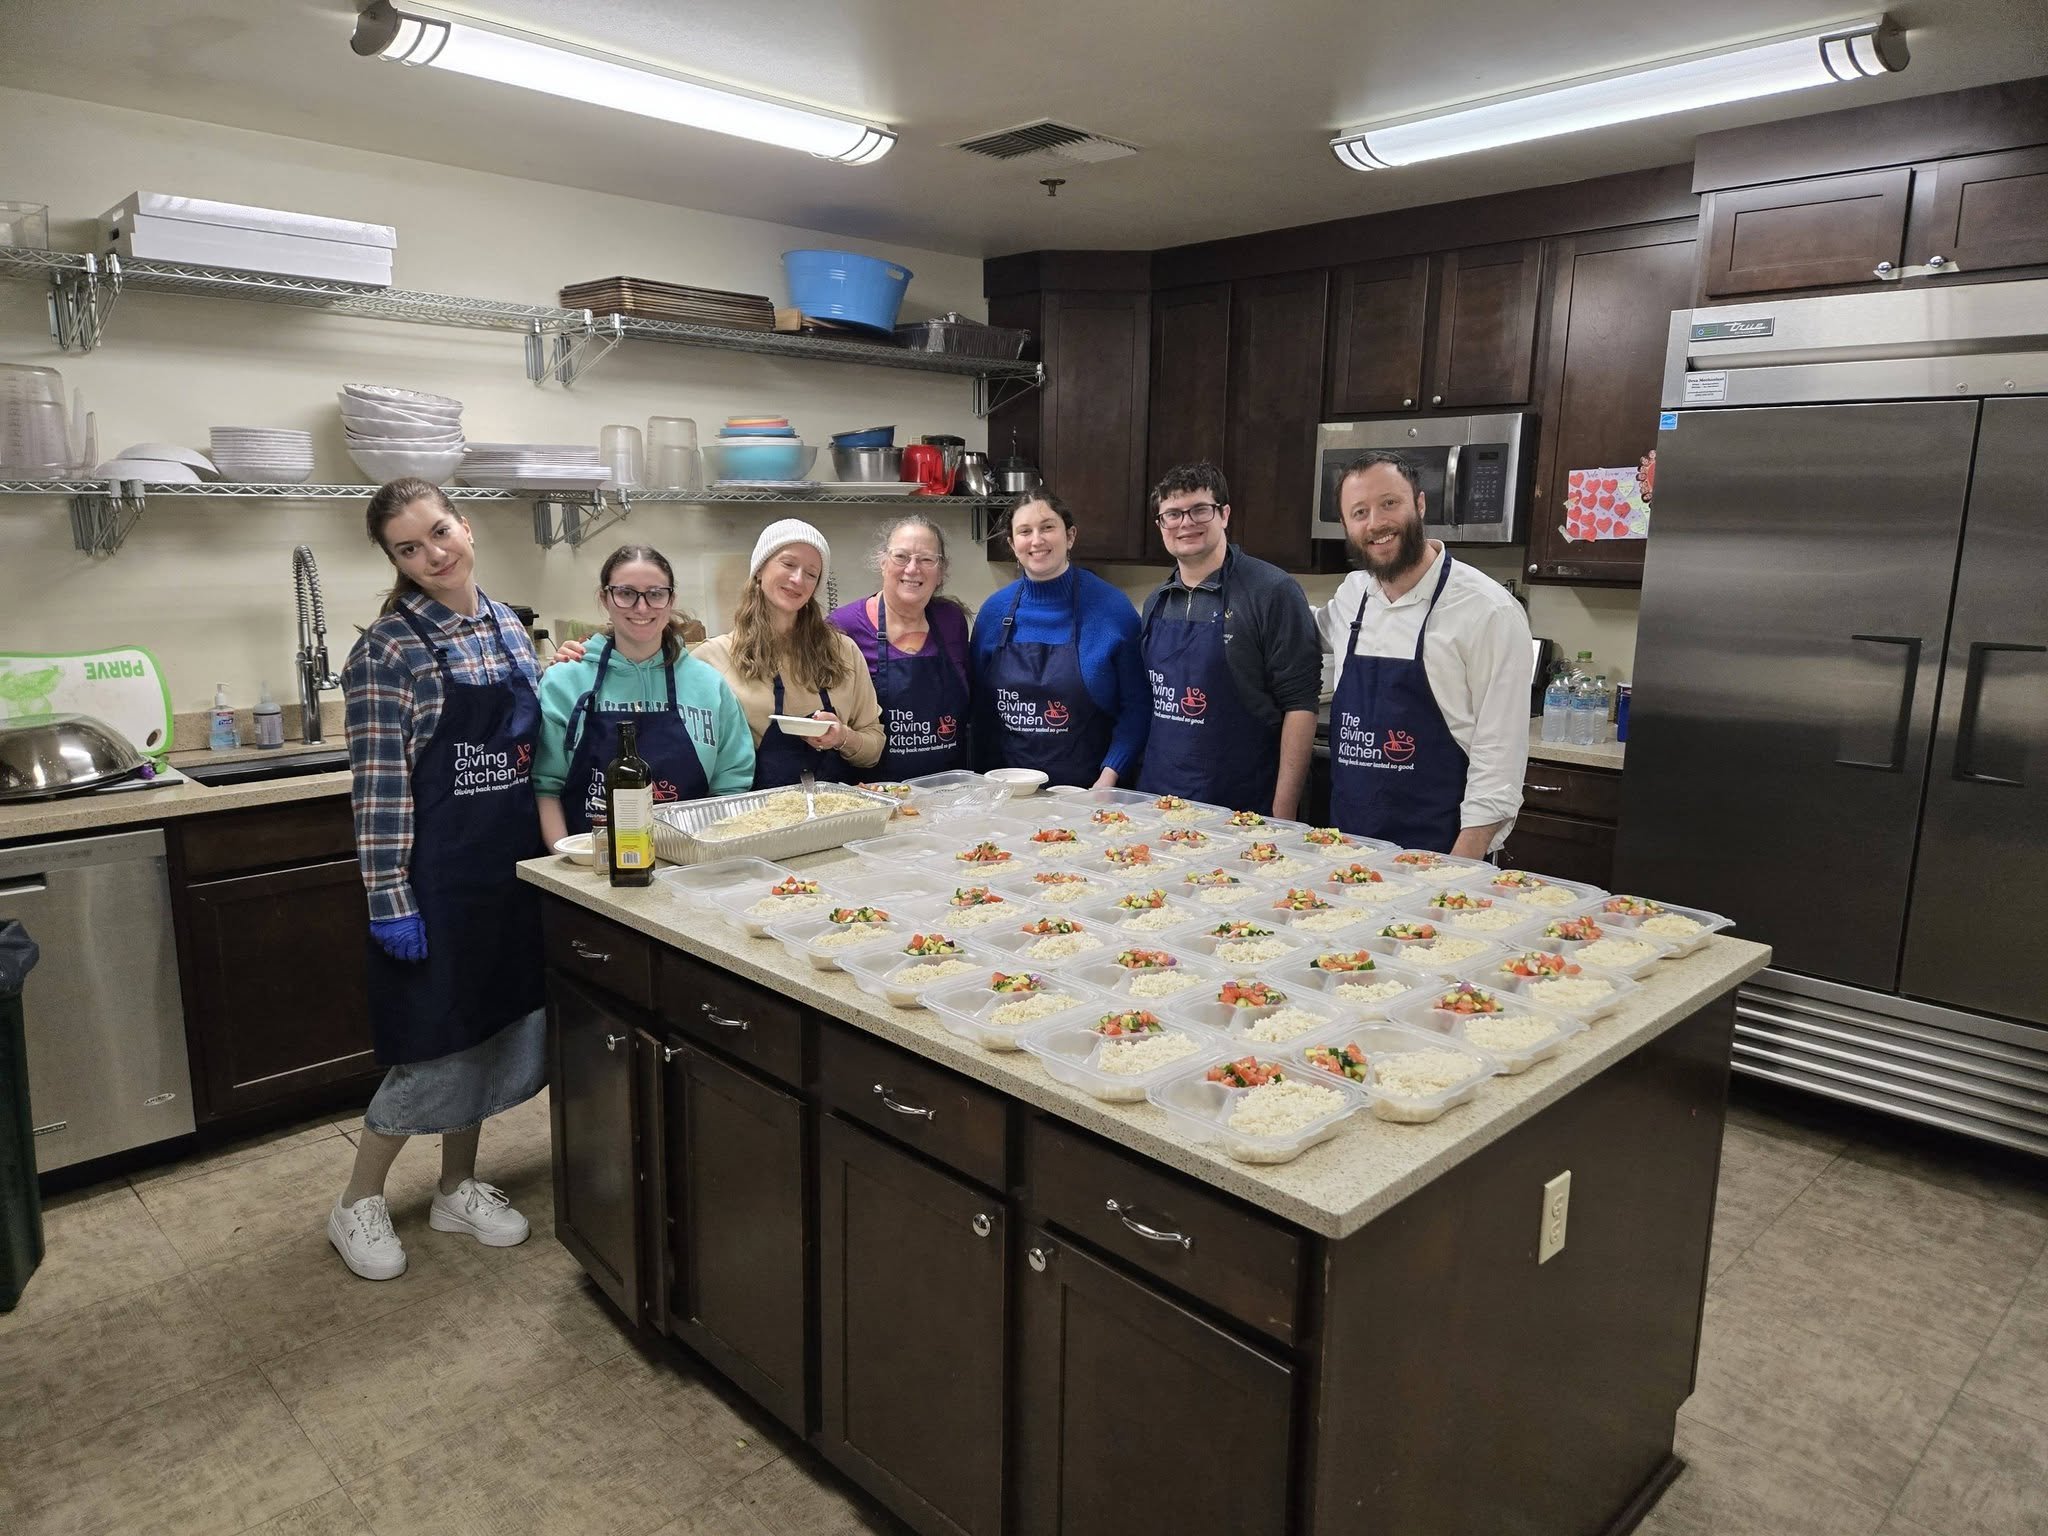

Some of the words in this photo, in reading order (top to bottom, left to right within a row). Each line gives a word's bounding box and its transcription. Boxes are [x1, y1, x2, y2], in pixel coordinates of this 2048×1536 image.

[85, 660, 144, 680] PARVE
[1149, 670, 1164, 682] The
[997, 689, 1019, 700] The
[1151, 682, 1175, 701] iving
[888, 709, 913, 720] The
[997, 700, 1036, 715] Giving
[1342, 713, 1360, 727] The
[890, 721, 930, 734] Giving
[889, 734, 936, 746] Kitchen
[1340, 727, 1375, 747] Giving
[454, 742, 484, 757] The
[1338, 742, 1382, 760] Kitchen
[455, 751, 507, 770] Giving
[455, 768, 517, 787] Kitchen
[592, 768, 605, 782] Th
[454, 788, 474, 796] Giving
[476, 784, 491, 792] back
